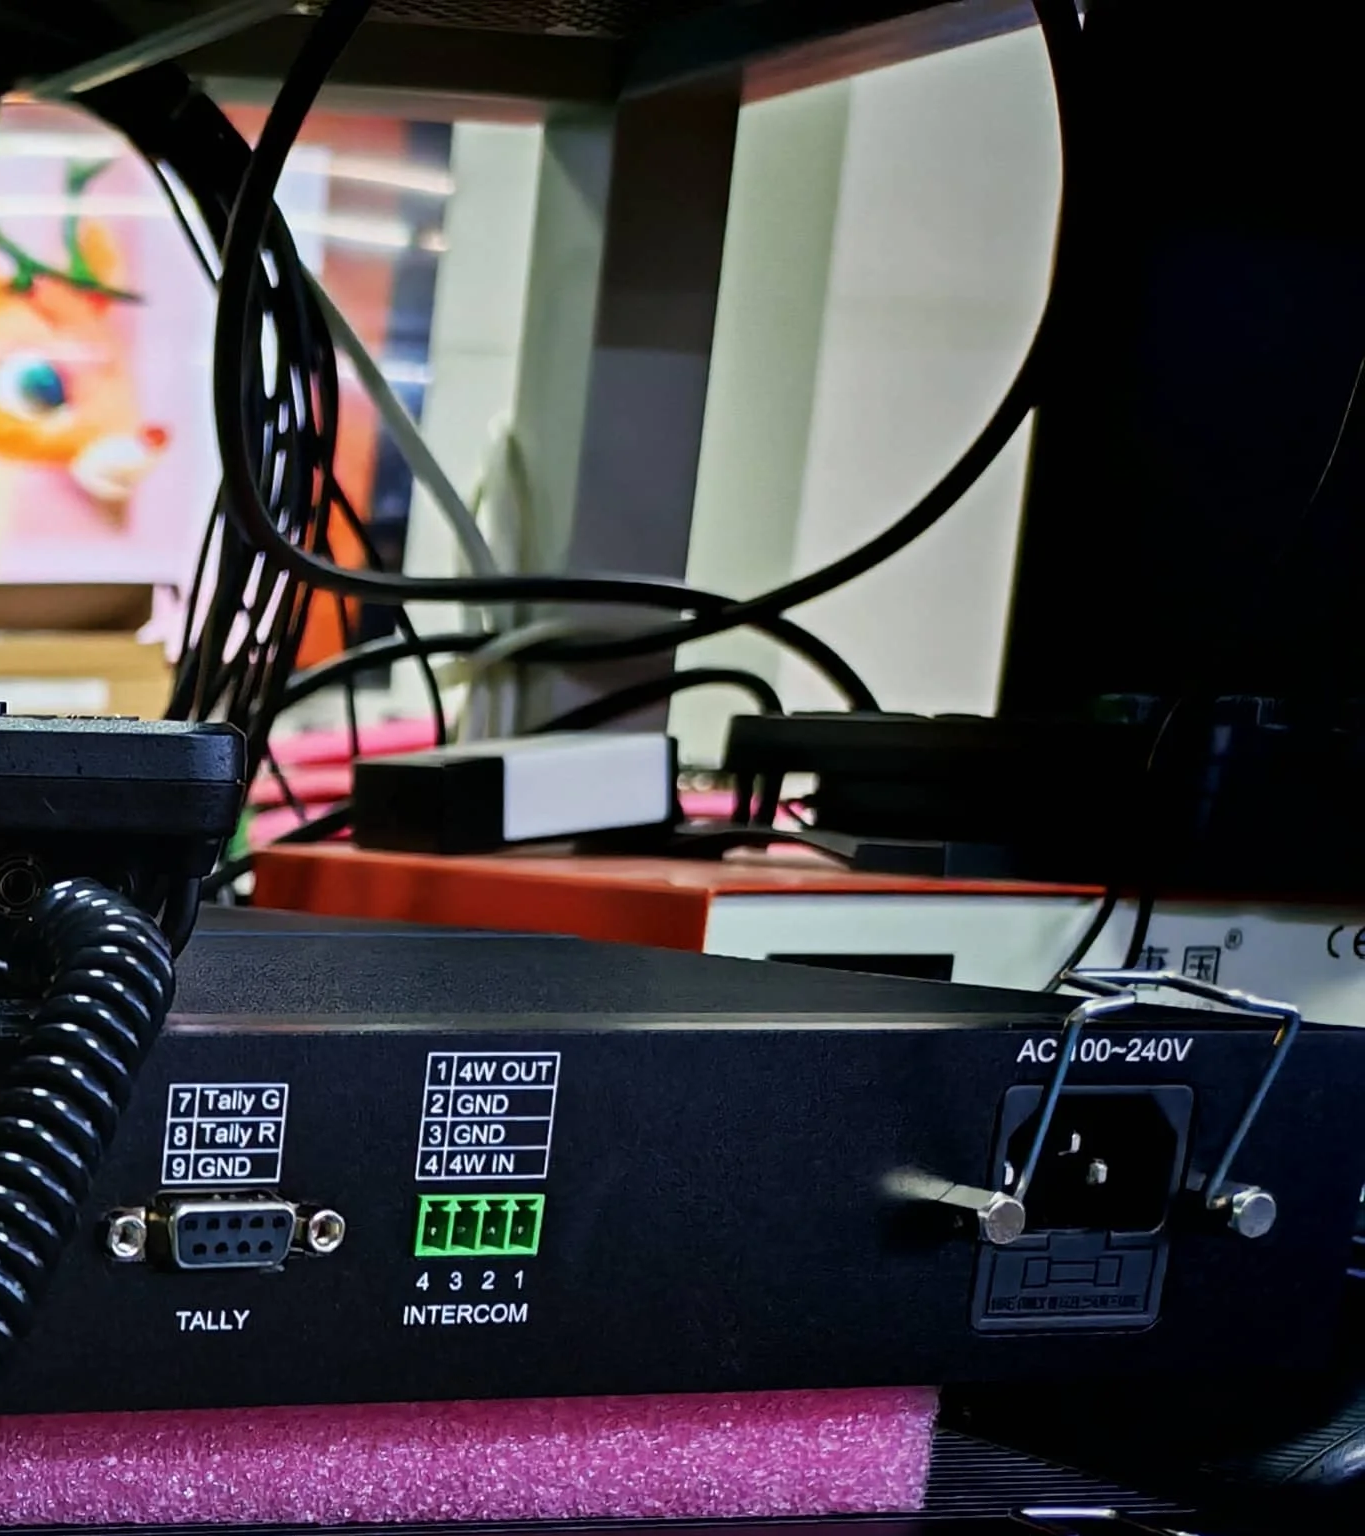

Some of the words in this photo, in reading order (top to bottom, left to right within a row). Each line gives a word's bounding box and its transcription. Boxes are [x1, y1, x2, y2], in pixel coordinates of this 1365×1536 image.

[1016, 1038, 1058, 1063] AC
[437, 1061, 448, 1081] 1
[458, 1061, 497, 1082] 4W
[501, 1061, 553, 1082] OUT
[177, 1092, 190, 1114] 7
[203, 1088, 257, 1114] Tally
[261, 1088, 280, 1110] G
[429, 1094, 444, 1114] 2
[456, 1094, 509, 1115] GND
[173, 1125, 188, 1146] 8
[202, 1120, 253, 1149] Tally
[257, 1122, 276, 1143] R
[428, 1125, 443, 1145] 3
[452, 1123, 506, 1144] GND
[170, 1158, 186, 1179] 9
[196, 1156, 252, 1178] GND
[424, 1157, 439, 1176] 4
[449, 1153, 486, 1175] 4W
[491, 1153, 515, 1174] IN
[415, 1271, 430, 1291] 4
[449, 1271, 463, 1291] 3
[481, 1270, 496, 1290] 2
[514, 1270, 524, 1289] 1
[175, 1309, 250, 1331] TALLY
[403, 1302, 528, 1326] INTERCOM
